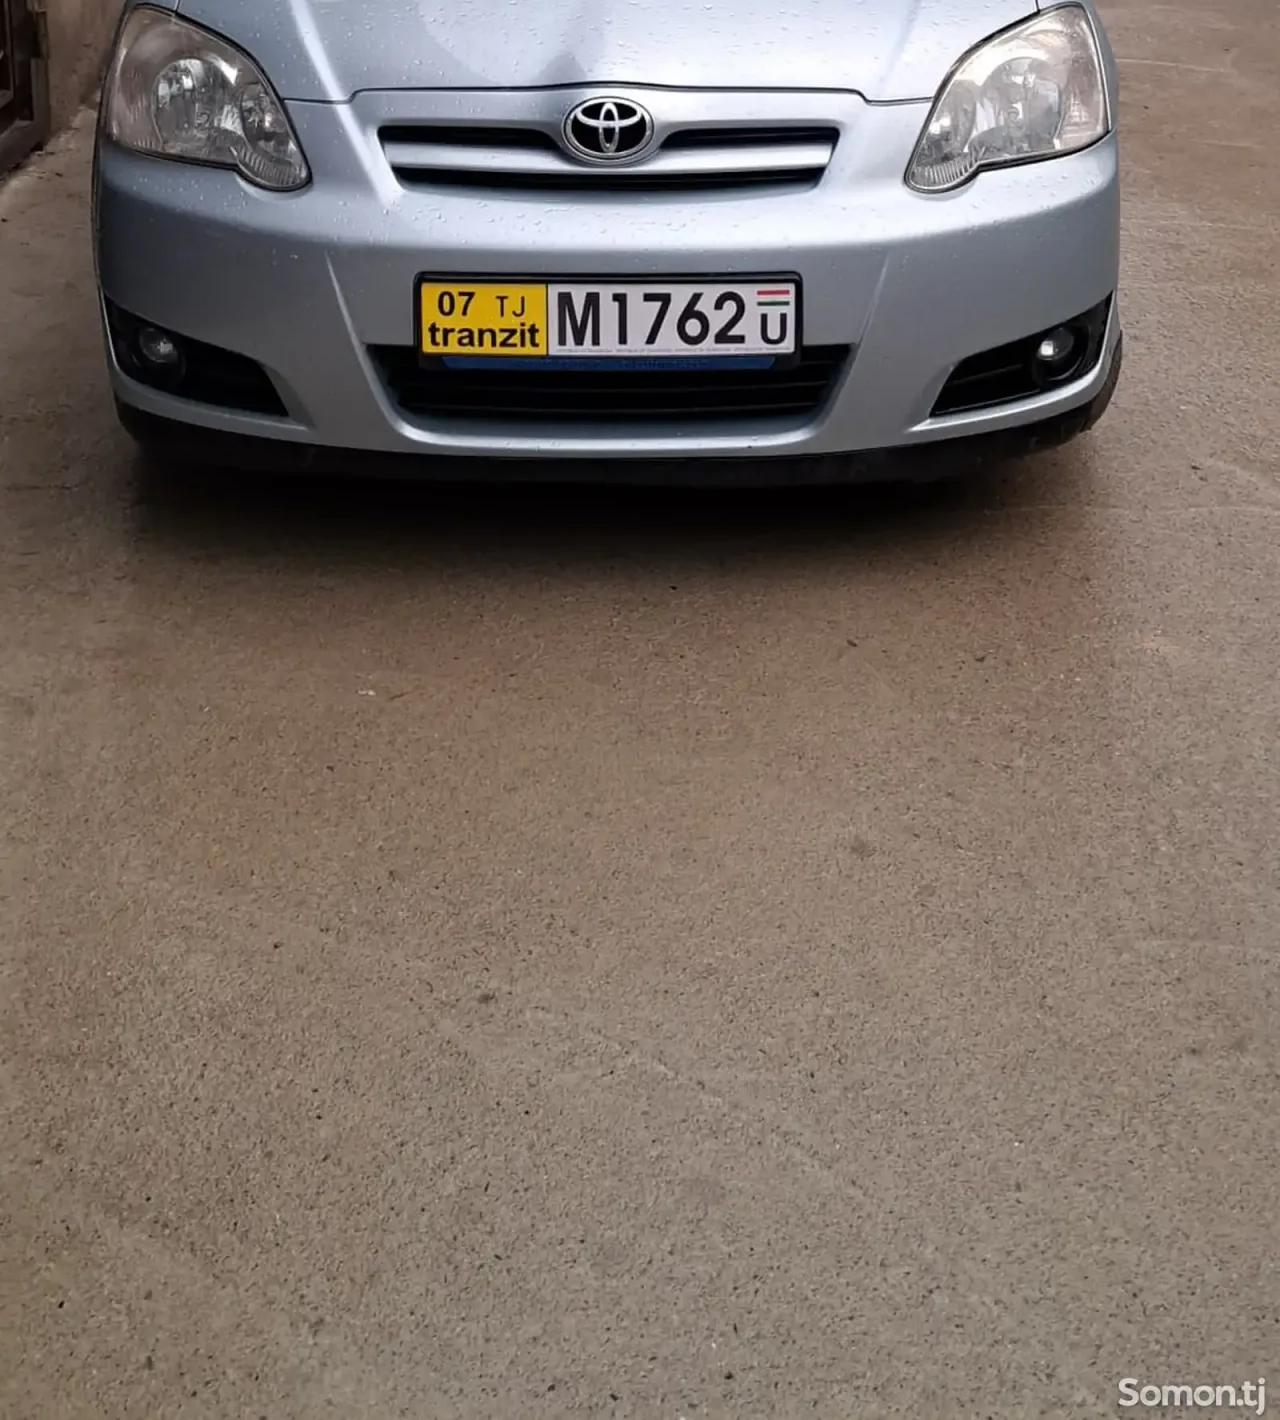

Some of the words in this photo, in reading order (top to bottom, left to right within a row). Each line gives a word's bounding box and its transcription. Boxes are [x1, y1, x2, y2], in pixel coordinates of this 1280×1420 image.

[437, 291, 476, 317] 07
[495, 295, 526, 318] TJ
[557, 291, 746, 347] M1762
[427, 321, 540, 349] tranzit
[760, 312, 788, 345] U
